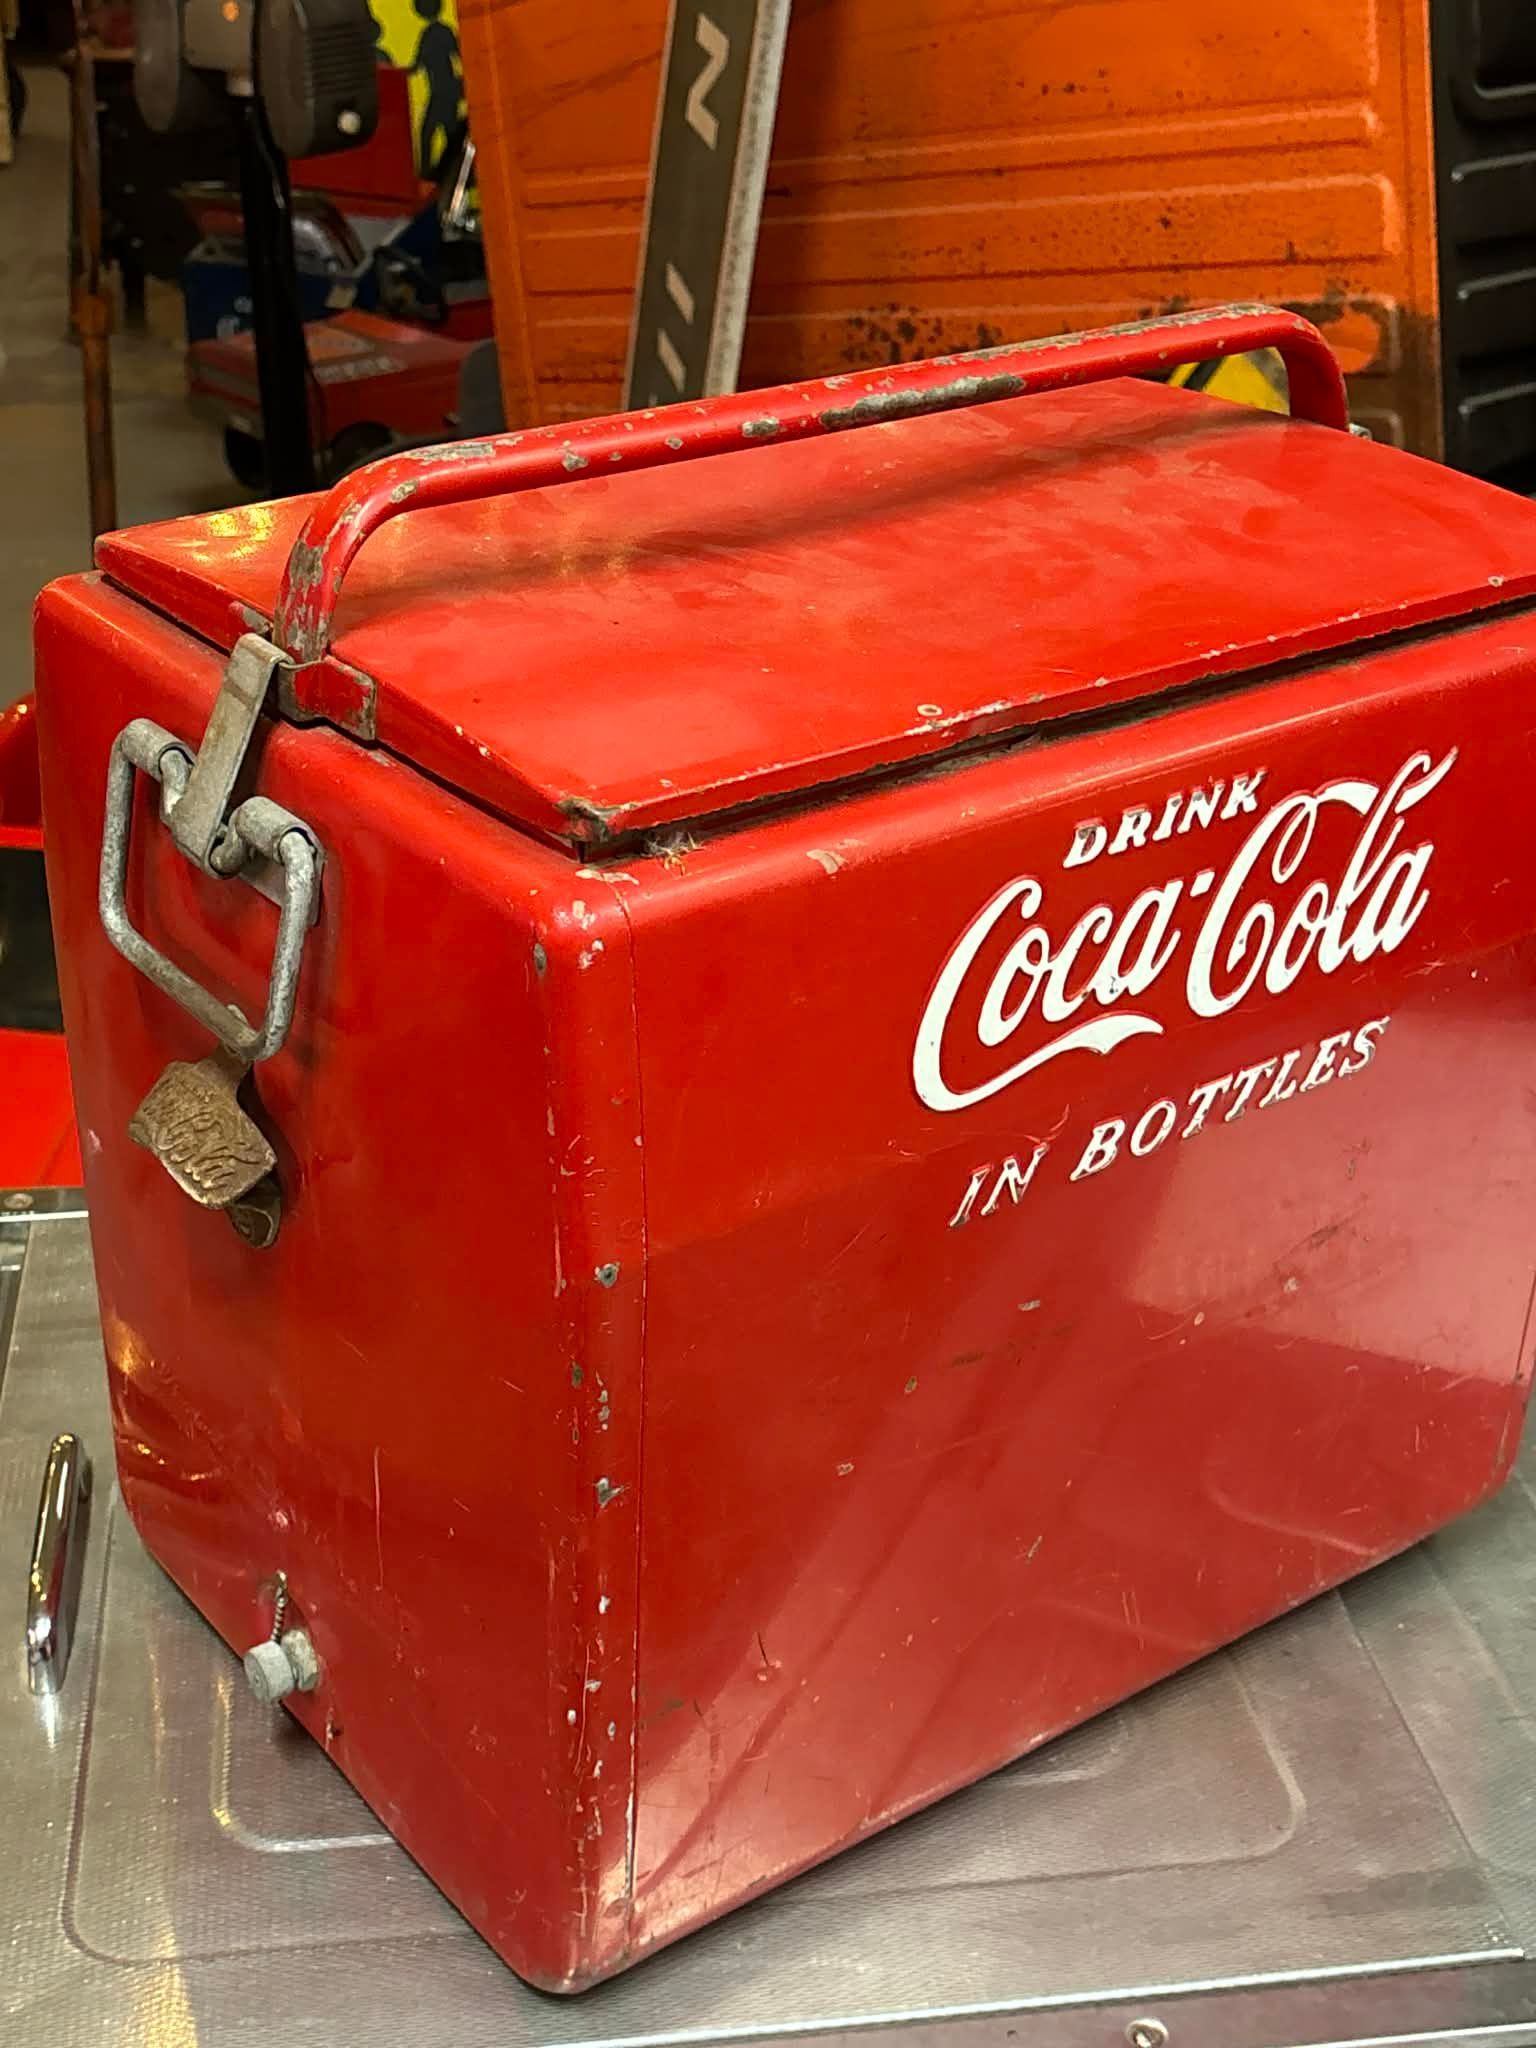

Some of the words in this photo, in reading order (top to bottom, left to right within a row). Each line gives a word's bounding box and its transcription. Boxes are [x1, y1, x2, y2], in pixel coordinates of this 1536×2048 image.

[1064, 767, 1268, 867] DRINK
[912, 745, 1459, 1112] Coca-Cola
[948, 1144, 1048, 1229] IN
[1069, 1015, 1390, 1182] BOTTLES
